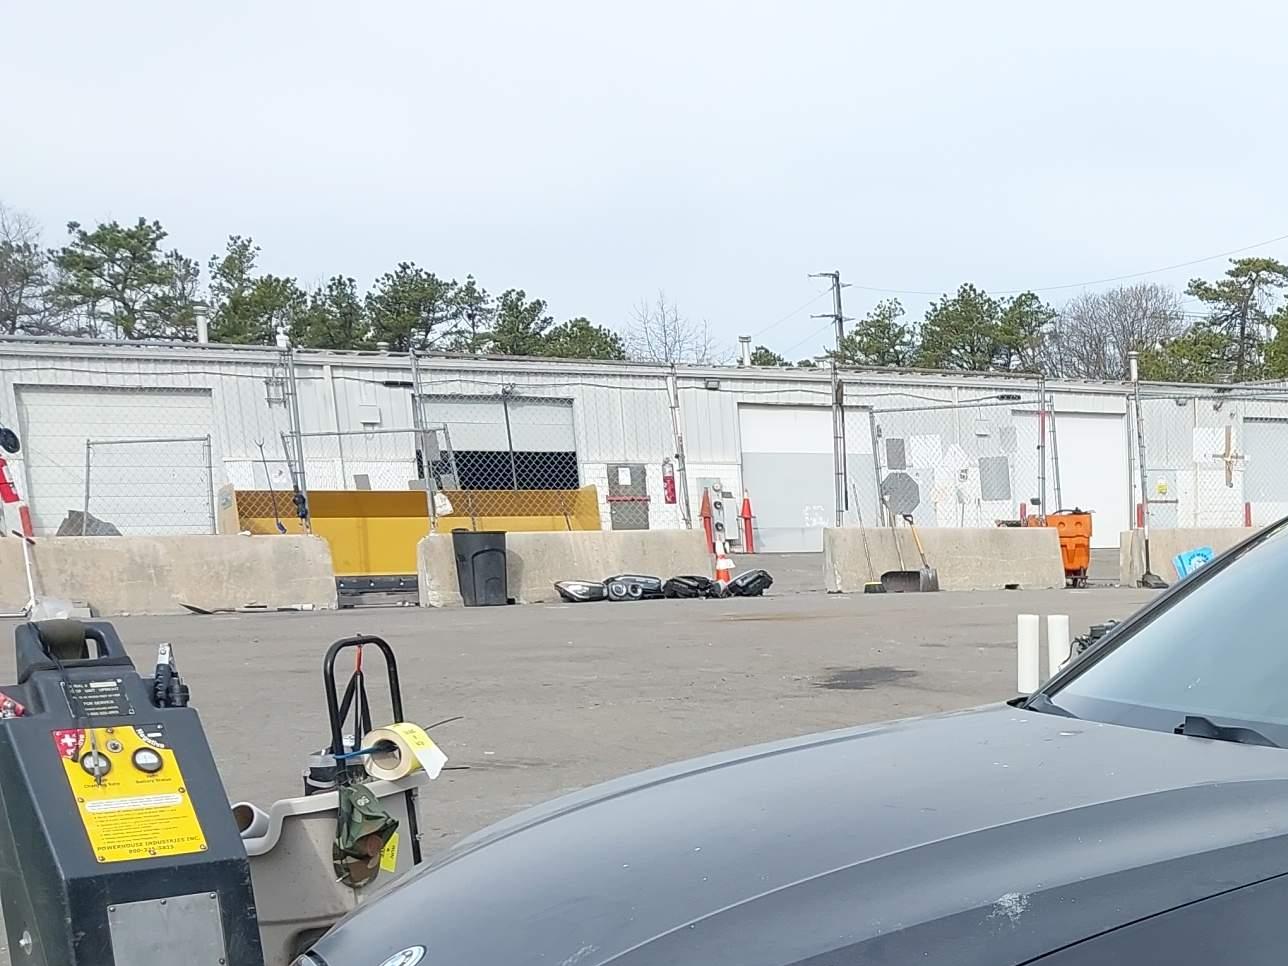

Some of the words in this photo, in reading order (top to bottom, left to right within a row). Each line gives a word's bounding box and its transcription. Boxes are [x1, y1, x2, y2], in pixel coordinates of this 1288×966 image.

[135, 728, 165, 748] Negative
[97, 841, 143, 852] POWERHOUSE
[145, 837, 185, 847] INDUSTRIES
